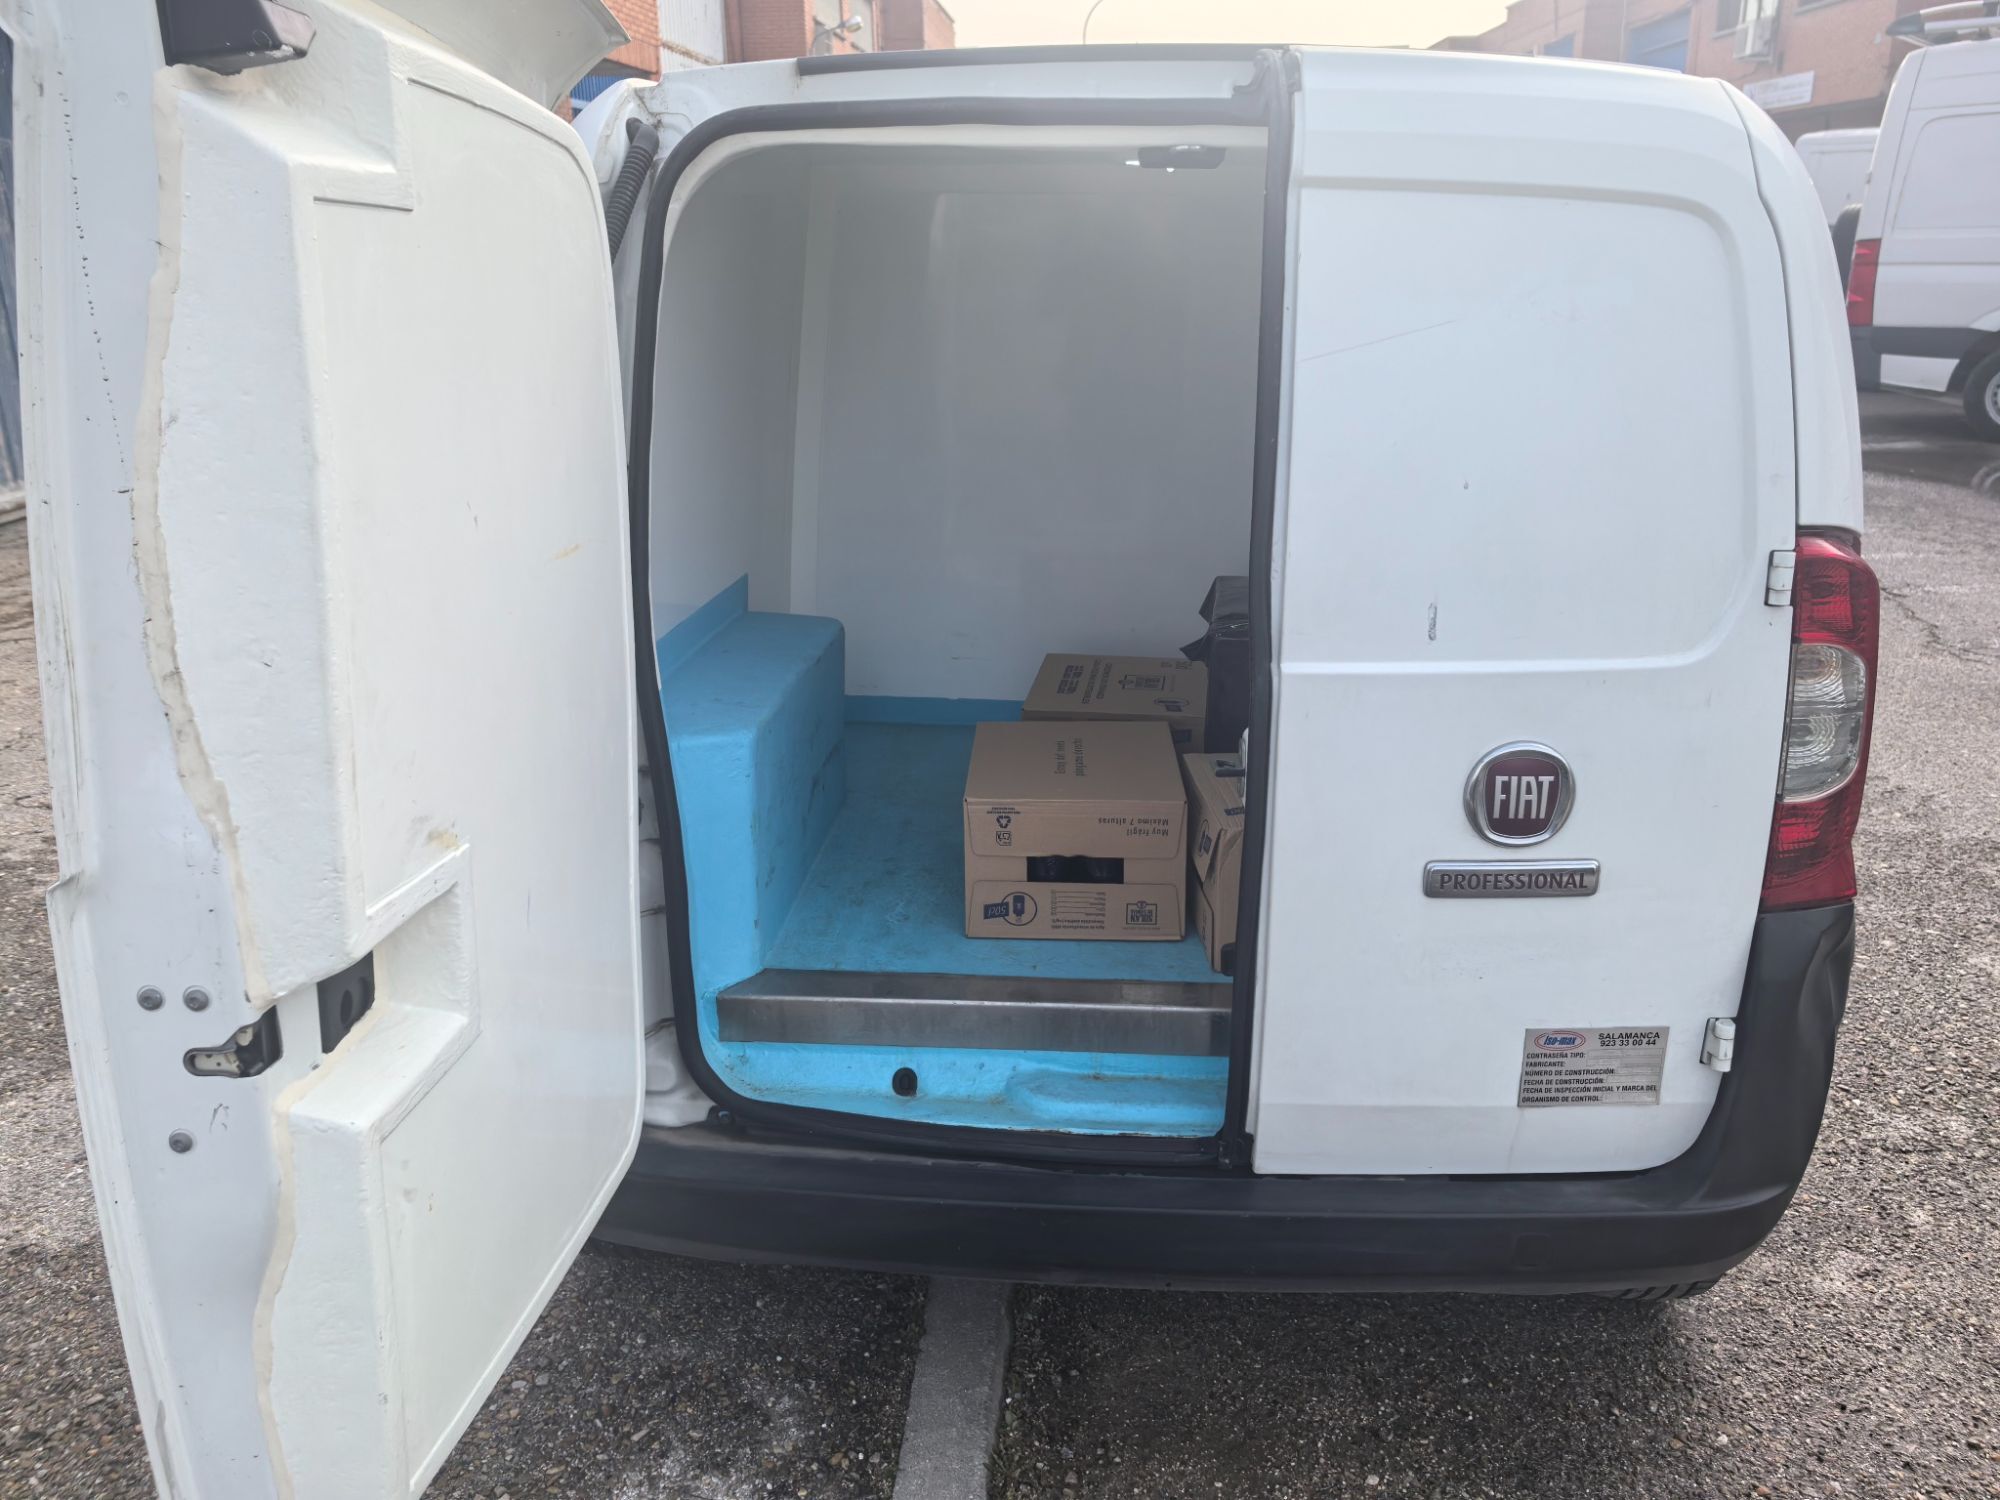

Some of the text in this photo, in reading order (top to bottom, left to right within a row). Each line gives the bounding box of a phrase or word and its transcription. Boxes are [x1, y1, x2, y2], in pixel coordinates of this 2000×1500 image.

[1493, 775, 1554, 819] FIAT
[1440, 872, 1588, 890] PROFESSIONAL
[1598, 1032, 1660, 1040] SALAMANCA
[1600, 1039, 1616, 1047] 923
[1526, 1051, 1568, 1059] CONTRASEÑA
[1554, 1086, 1591, 1094] INSPECCIÓN
[1561, 1095, 1569, 1103] DE
